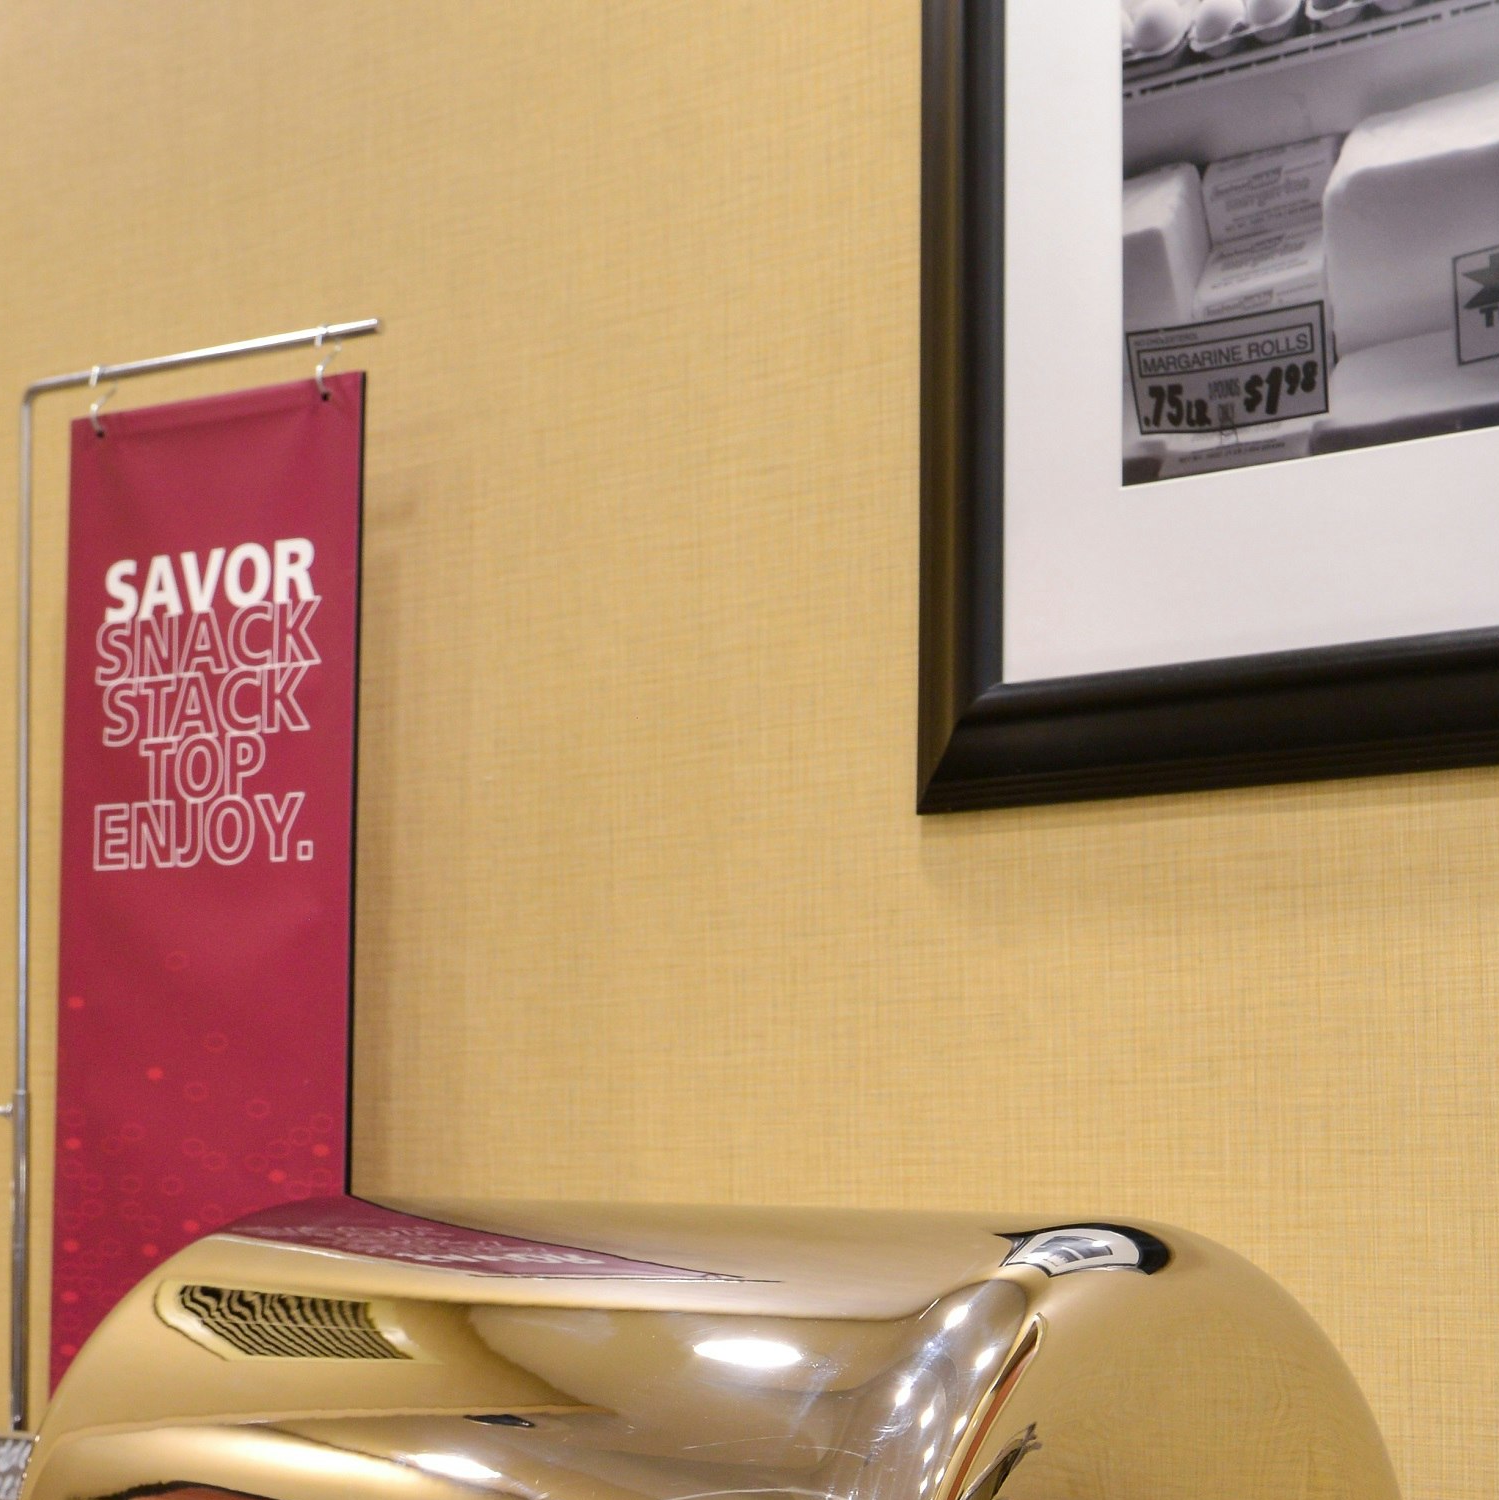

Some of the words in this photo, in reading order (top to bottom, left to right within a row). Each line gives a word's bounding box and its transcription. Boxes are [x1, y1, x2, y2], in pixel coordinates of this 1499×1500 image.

[1142, 345, 1242, 373] MARGARINE
[1248, 333, 1309, 359] ROLLS
[104, 537, 316, 623] SAVOR
[95, 595, 322, 686] SNACK
[102, 662, 311, 747] STACK
[139, 731, 267, 804] TOP
[93, 791, 314, 871] ENJOY.
